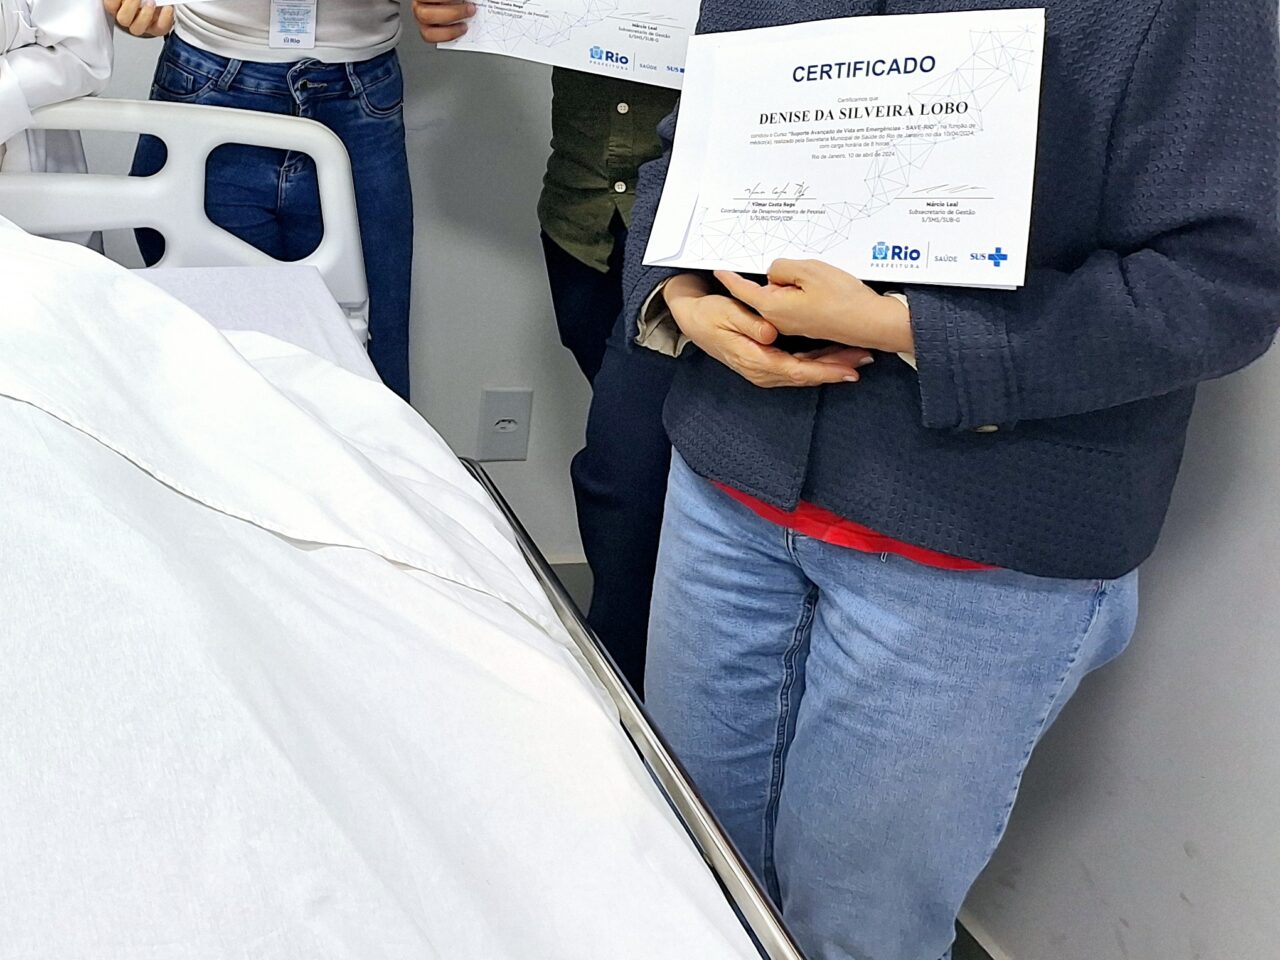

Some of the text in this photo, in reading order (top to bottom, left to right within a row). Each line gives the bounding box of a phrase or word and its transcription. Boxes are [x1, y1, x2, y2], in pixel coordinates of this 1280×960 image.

[605, 50, 629, 64] Rio
[792, 56, 936, 82] CERTIFICADO
[760, 102, 968, 124] DENISE DA SILVEIRA LOBO
[891, 245, 920, 261] Rio
[934, 254, 958, 262] SAÚDE
[970, 252, 986, 260] SUS
